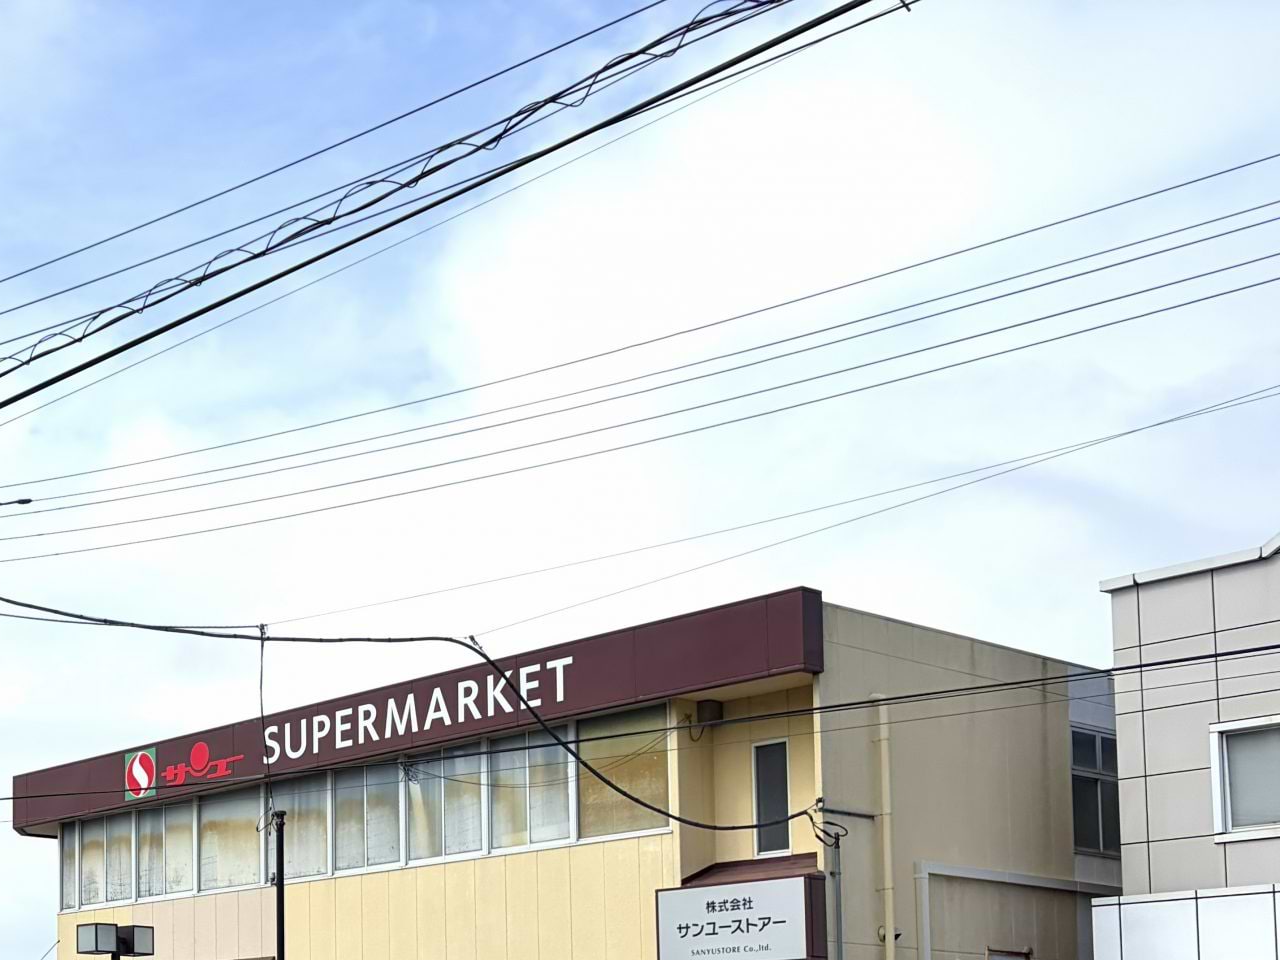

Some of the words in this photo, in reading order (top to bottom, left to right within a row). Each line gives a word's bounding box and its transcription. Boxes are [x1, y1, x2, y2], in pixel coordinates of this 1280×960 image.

[262, 656, 573, 764] SUPERMARKET
[706, 897, 754, 913] 株式会社
[677, 917, 786, 938] サンユーストアー
[691, 946, 740, 956] SANYUSTORE
